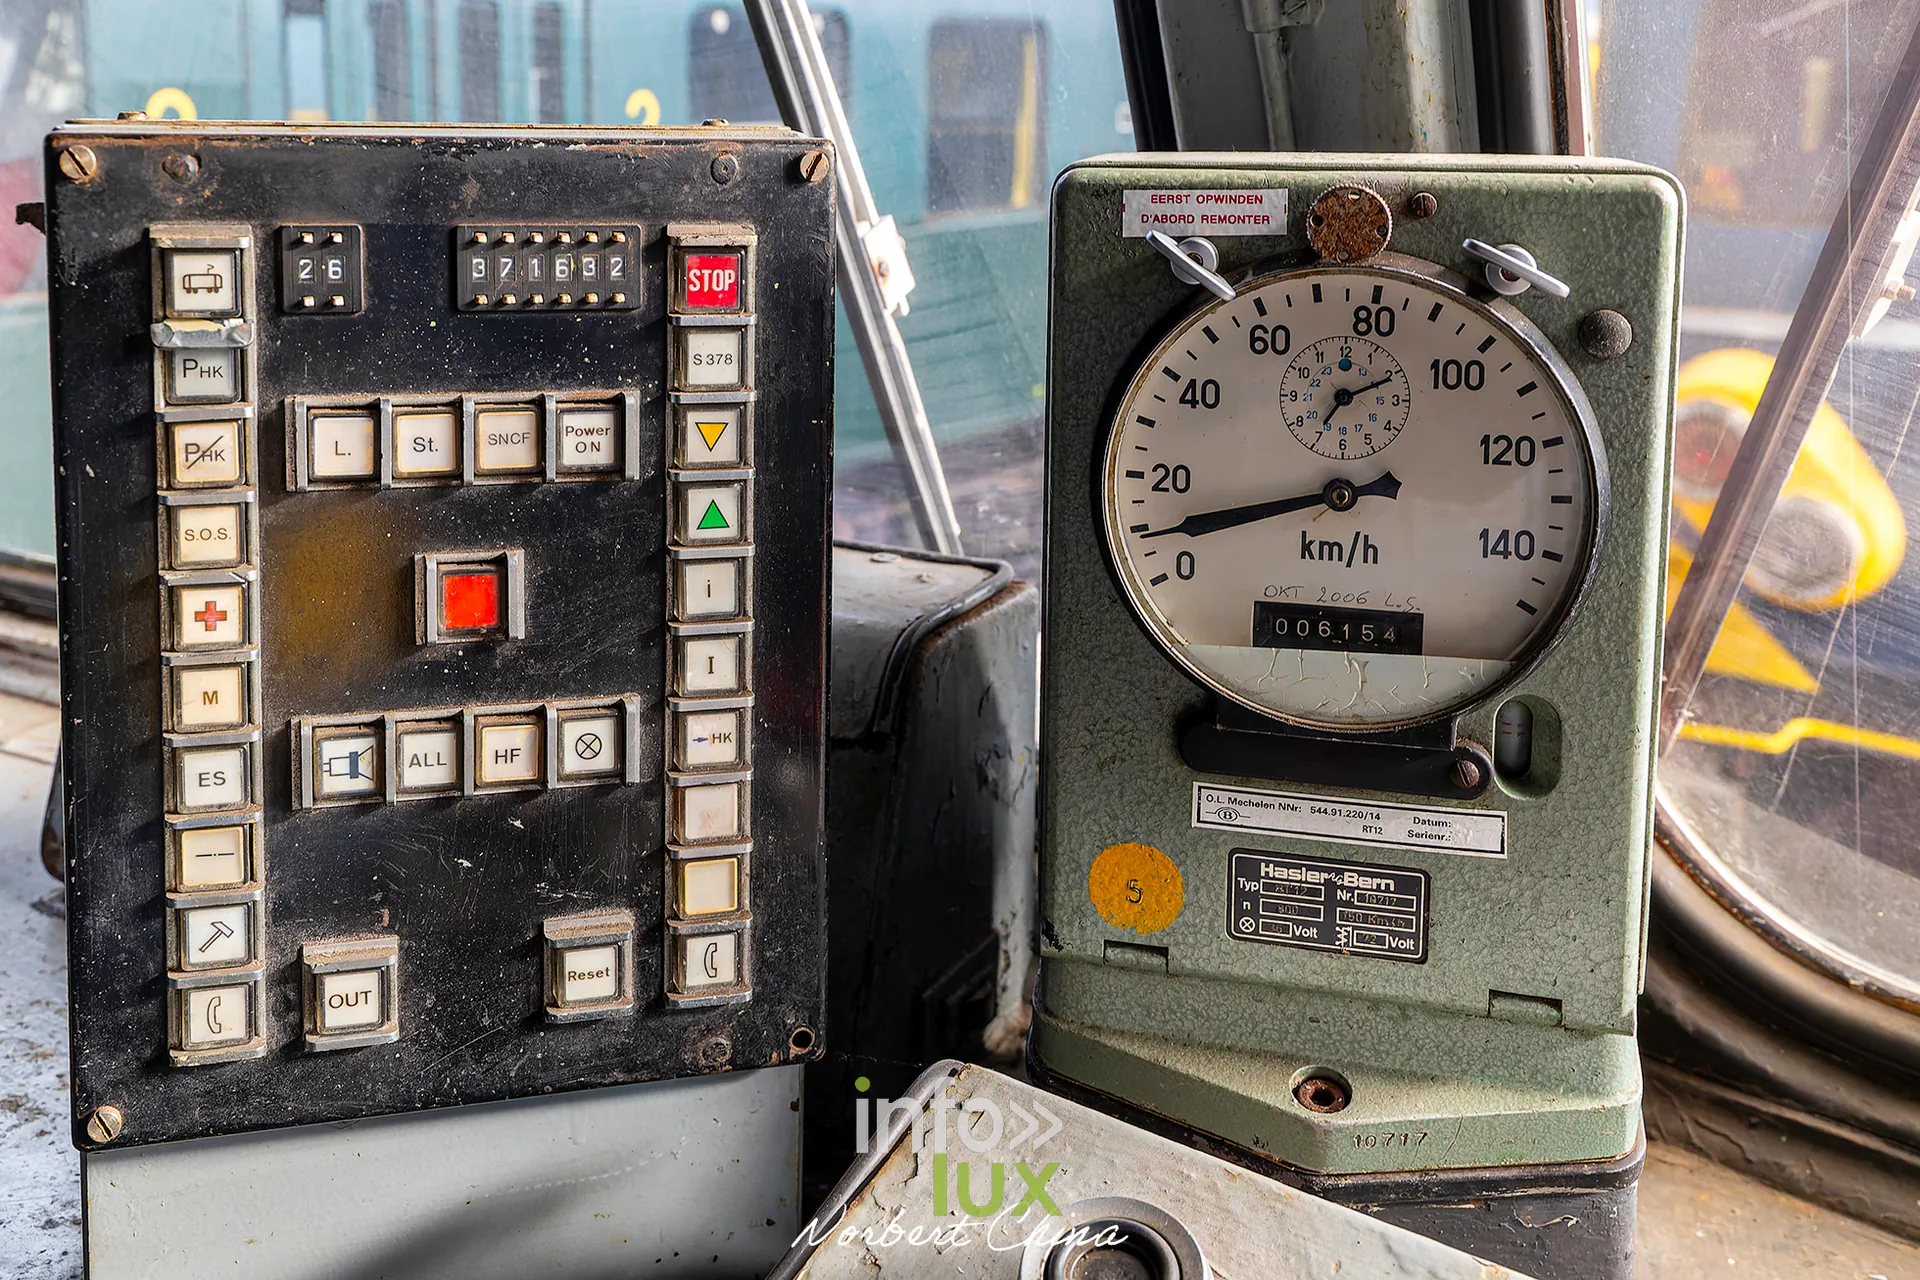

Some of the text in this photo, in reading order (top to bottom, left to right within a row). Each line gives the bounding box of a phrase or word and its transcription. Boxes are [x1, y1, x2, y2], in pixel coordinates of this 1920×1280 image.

[1150, 194, 1263, 205] EERST OPWINDEN
[1141, 213, 1271, 225] D'ABORD REMONTER
[688, 268, 736, 293] STOP
[1352, 305, 1396, 338] 80
[1249, 323, 1292, 356] 60
[1315, 351, 1325, 363] 11
[1339, 345, 1352, 358] 12
[1367, 352, 1373, 365] 1
[1297, 366, 1310, 379] 10
[1320, 366, 1333, 376] 23
[1358, 367, 1368, 377] 13
[1430, 358, 1486, 392] 100
[1309, 378, 1321, 388] 22
[1178, 377, 1221, 410] 40
[1289, 389, 1298, 402] 9
[1302, 392, 1313, 402] 21
[1391, 394, 1400, 407] 3
[1375, 396, 1385, 406] 15
[1295, 415, 1304, 427] 8
[1306, 410, 1318, 420] 20
[1368, 412, 1378, 422] 16
[564, 424, 612, 438] Power
[1338, 426, 1348, 436] 18
[1354, 423, 1363, 432] 17
[1383, 419, 1392, 432] 4
[487, 431, 532, 447] SNCF
[1315, 430, 1323, 443] 7
[1363, 433, 1373, 446] 5
[334, 440, 352, 457] L.
[412, 436, 439, 453] St.
[574, 440, 602, 454] ON
[1338, 438, 1347, 451] 6
[1479, 433, 1537, 467] 120
[1151, 462, 1192, 494] 20
[184, 527, 233, 542] S.O.S.
[1300, 530, 1379, 569] km/h
[1478, 527, 1535, 561] 140
[1175, 550, 1196, 581] 0
[1263, 584, 1305, 598] OKT
[1316, 586, 1370, 605] 2006
[202, 690, 219, 706] M
[711, 732, 734, 745] HK
[408, 752, 448, 769] ALL
[494, 747, 522, 765] HF
[198, 770, 227, 787] ES
[1205, 793, 1382, 821] O.L. Mechelen NNr: 544.91.220/14
[1412, 816, 1453, 828] Datum:
[1361, 824, 1384, 836] RT12
[1406, 829, 1452, 842] Serienr.:
[1260, 862, 1329, 884] Hasler
[1343, 871, 1395, 892] Bern
[1126, 878, 1144, 904] 5
[1237, 877, 1260, 893] Typ
[1336, 888, 1354, 902] Nr.
[1242, 900, 1252, 911] n
[1293, 924, 1319, 939] Volt
[1389, 935, 1416, 950] Volt
[567, 966, 611, 983] Reset
[328, 990, 373, 1010] OUT
